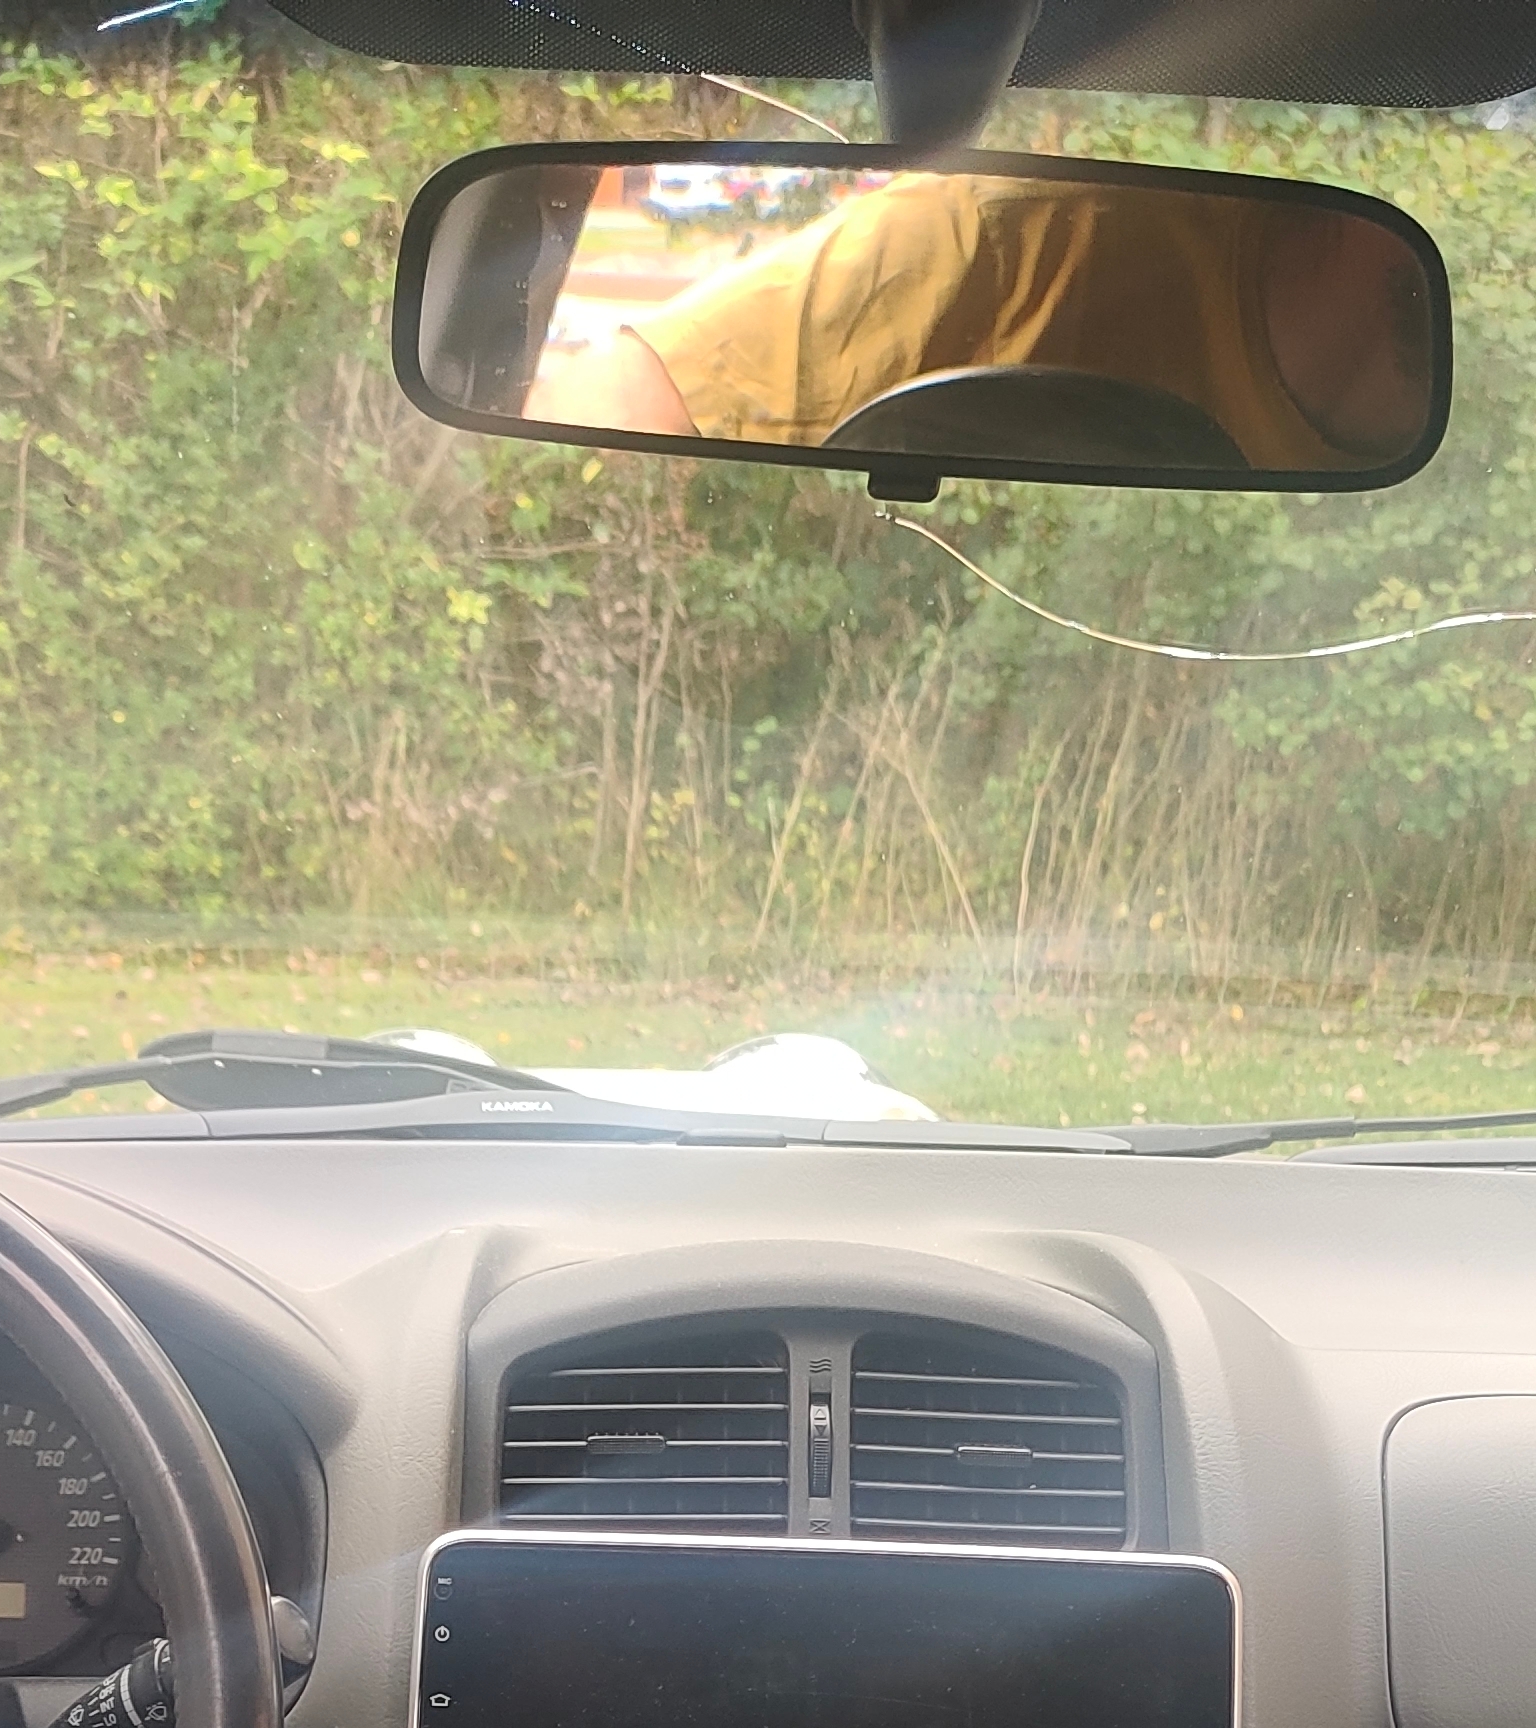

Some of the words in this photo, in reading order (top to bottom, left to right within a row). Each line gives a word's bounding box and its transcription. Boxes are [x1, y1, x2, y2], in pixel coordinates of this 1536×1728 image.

[481, 1101, 554, 1113] KAMOKA
[6, 1428, 37, 1447] 140
[34, 1448, 66, 1468] 160
[58, 1477, 89, 1496] 180
[67, 1510, 101, 1528] 200
[68, 1547, 104, 1566] 220
[57, 1573, 110, 1588] km/h
